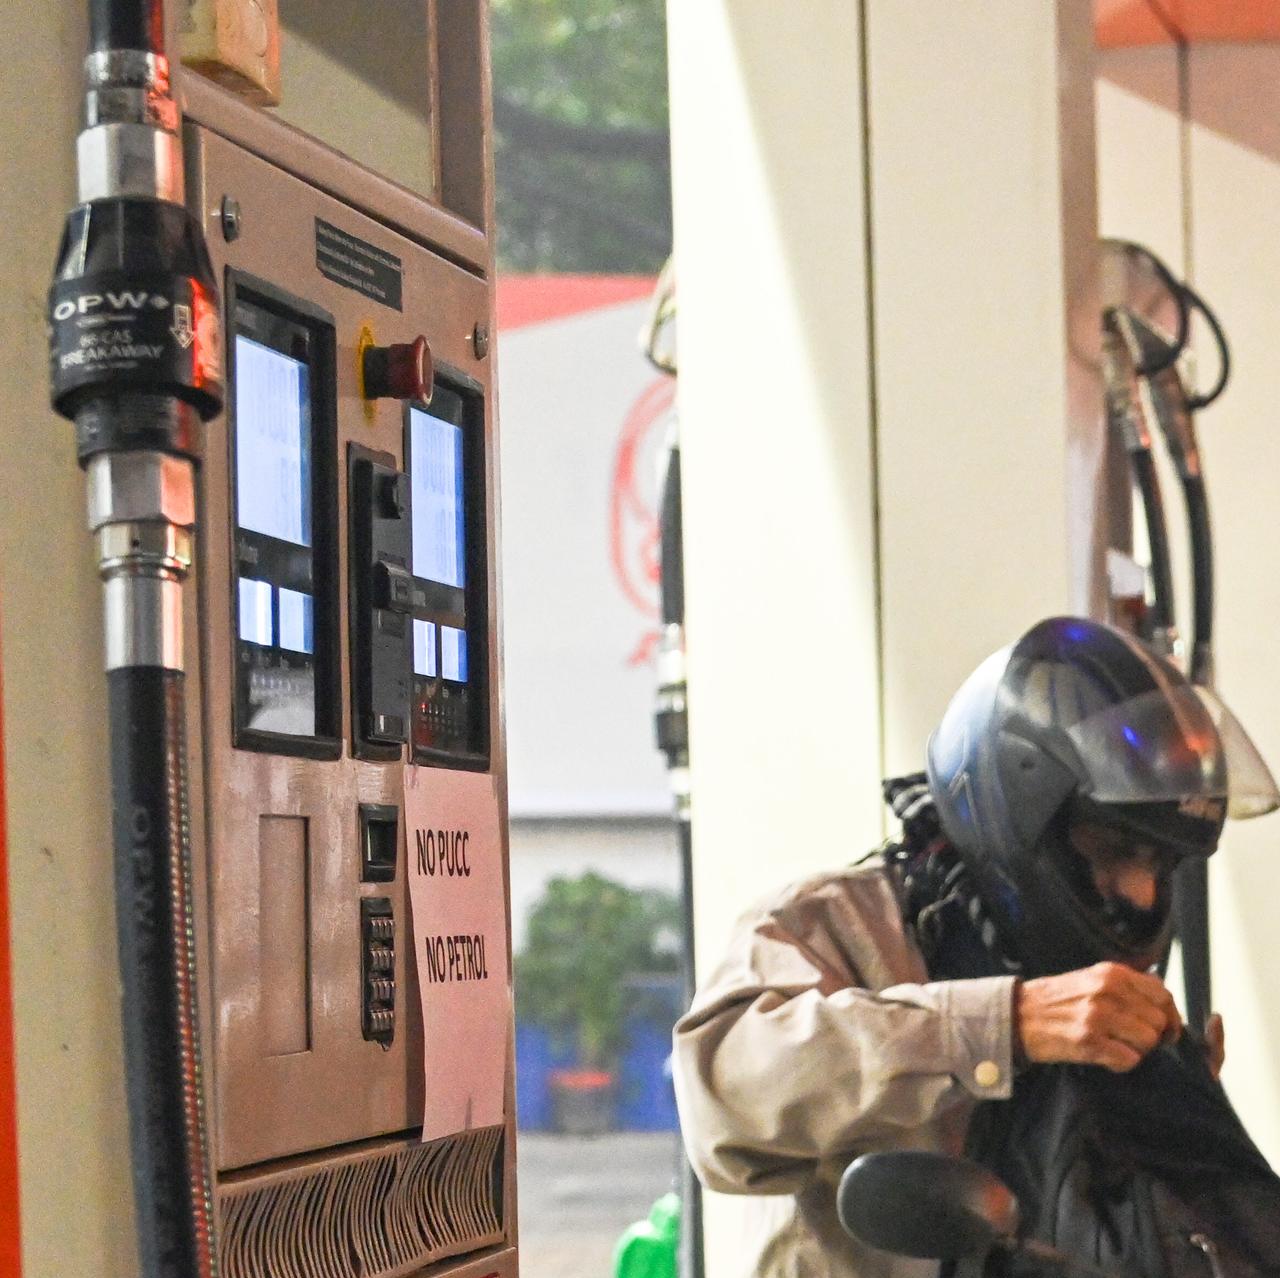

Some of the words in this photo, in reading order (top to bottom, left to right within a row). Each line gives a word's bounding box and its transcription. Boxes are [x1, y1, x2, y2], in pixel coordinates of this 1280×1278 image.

[54, 291, 149, 321] OPW
[415, 829, 436, 877] NO
[438, 830, 471, 877] PUCC
[425, 936, 446, 984] NO
[447, 934, 488, 982] PETROL
